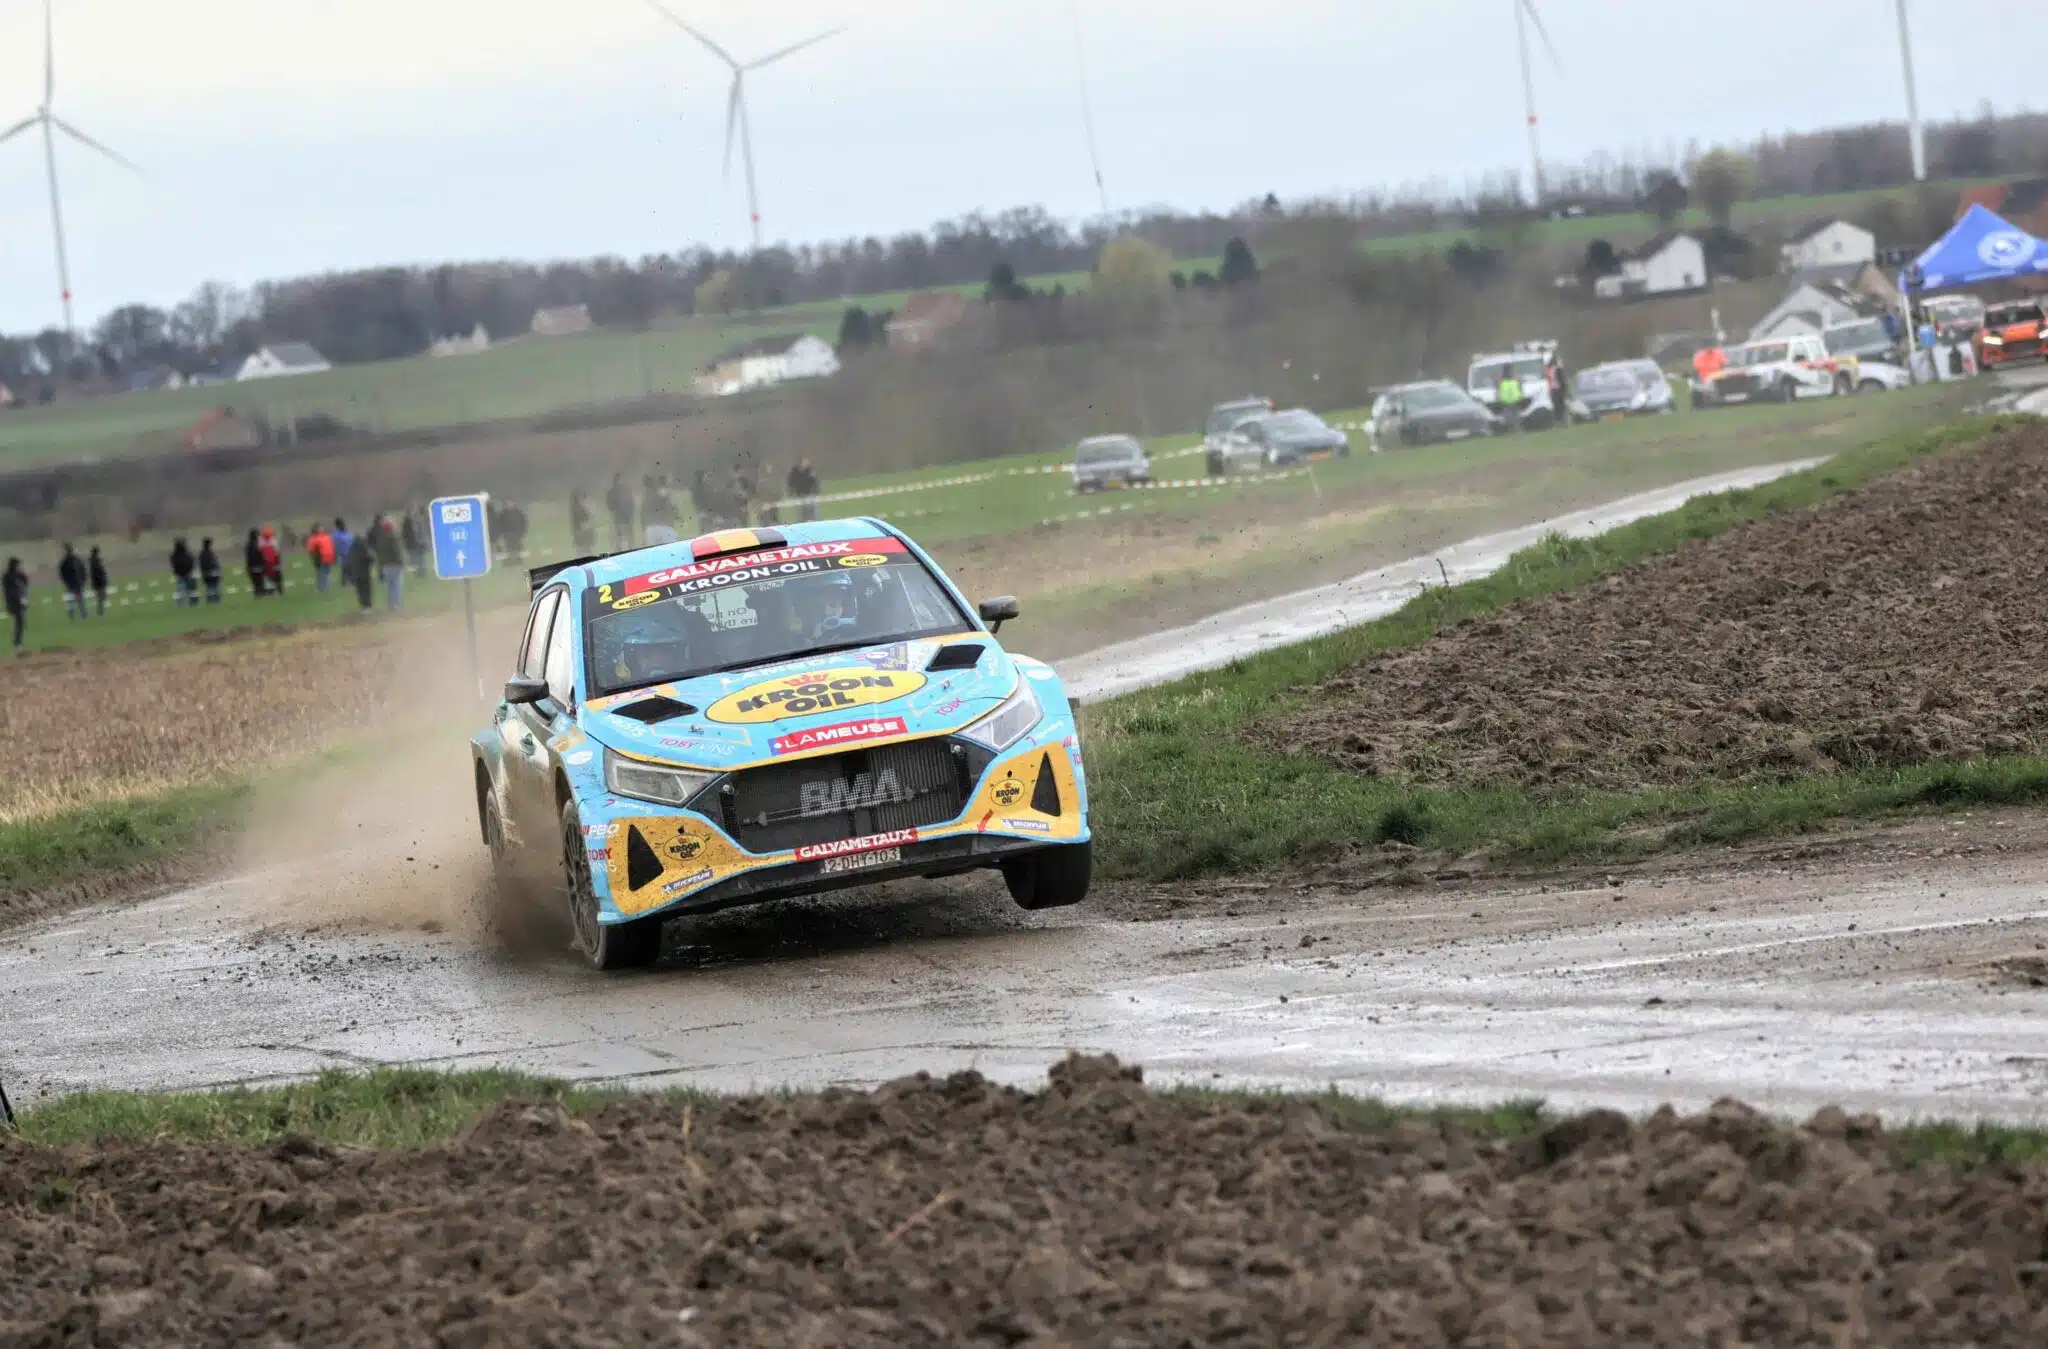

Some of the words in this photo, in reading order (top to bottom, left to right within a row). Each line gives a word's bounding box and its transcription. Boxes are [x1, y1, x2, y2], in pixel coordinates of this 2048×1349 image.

[648, 542, 855, 584] GALVAMETAUX
[680, 560, 820, 593] KROON-OIL
[598, 584, 613, 604] 2
[736, 675, 894, 712] KROON
[784, 692, 855, 712] OIL
[660, 738, 696, 748] TOBY
[800, 768, 902, 818] BMA
[995, 787, 1020, 798] KROON
[1001, 796, 1013, 804] OIL
[1012, 819, 1049, 830] MICHELIN
[669, 841, 701, 853] KROON
[800, 828, 913, 858] GALVAMETAUX
[680, 850, 695, 859] OIL
[672, 869, 713, 890] MICHELIN
